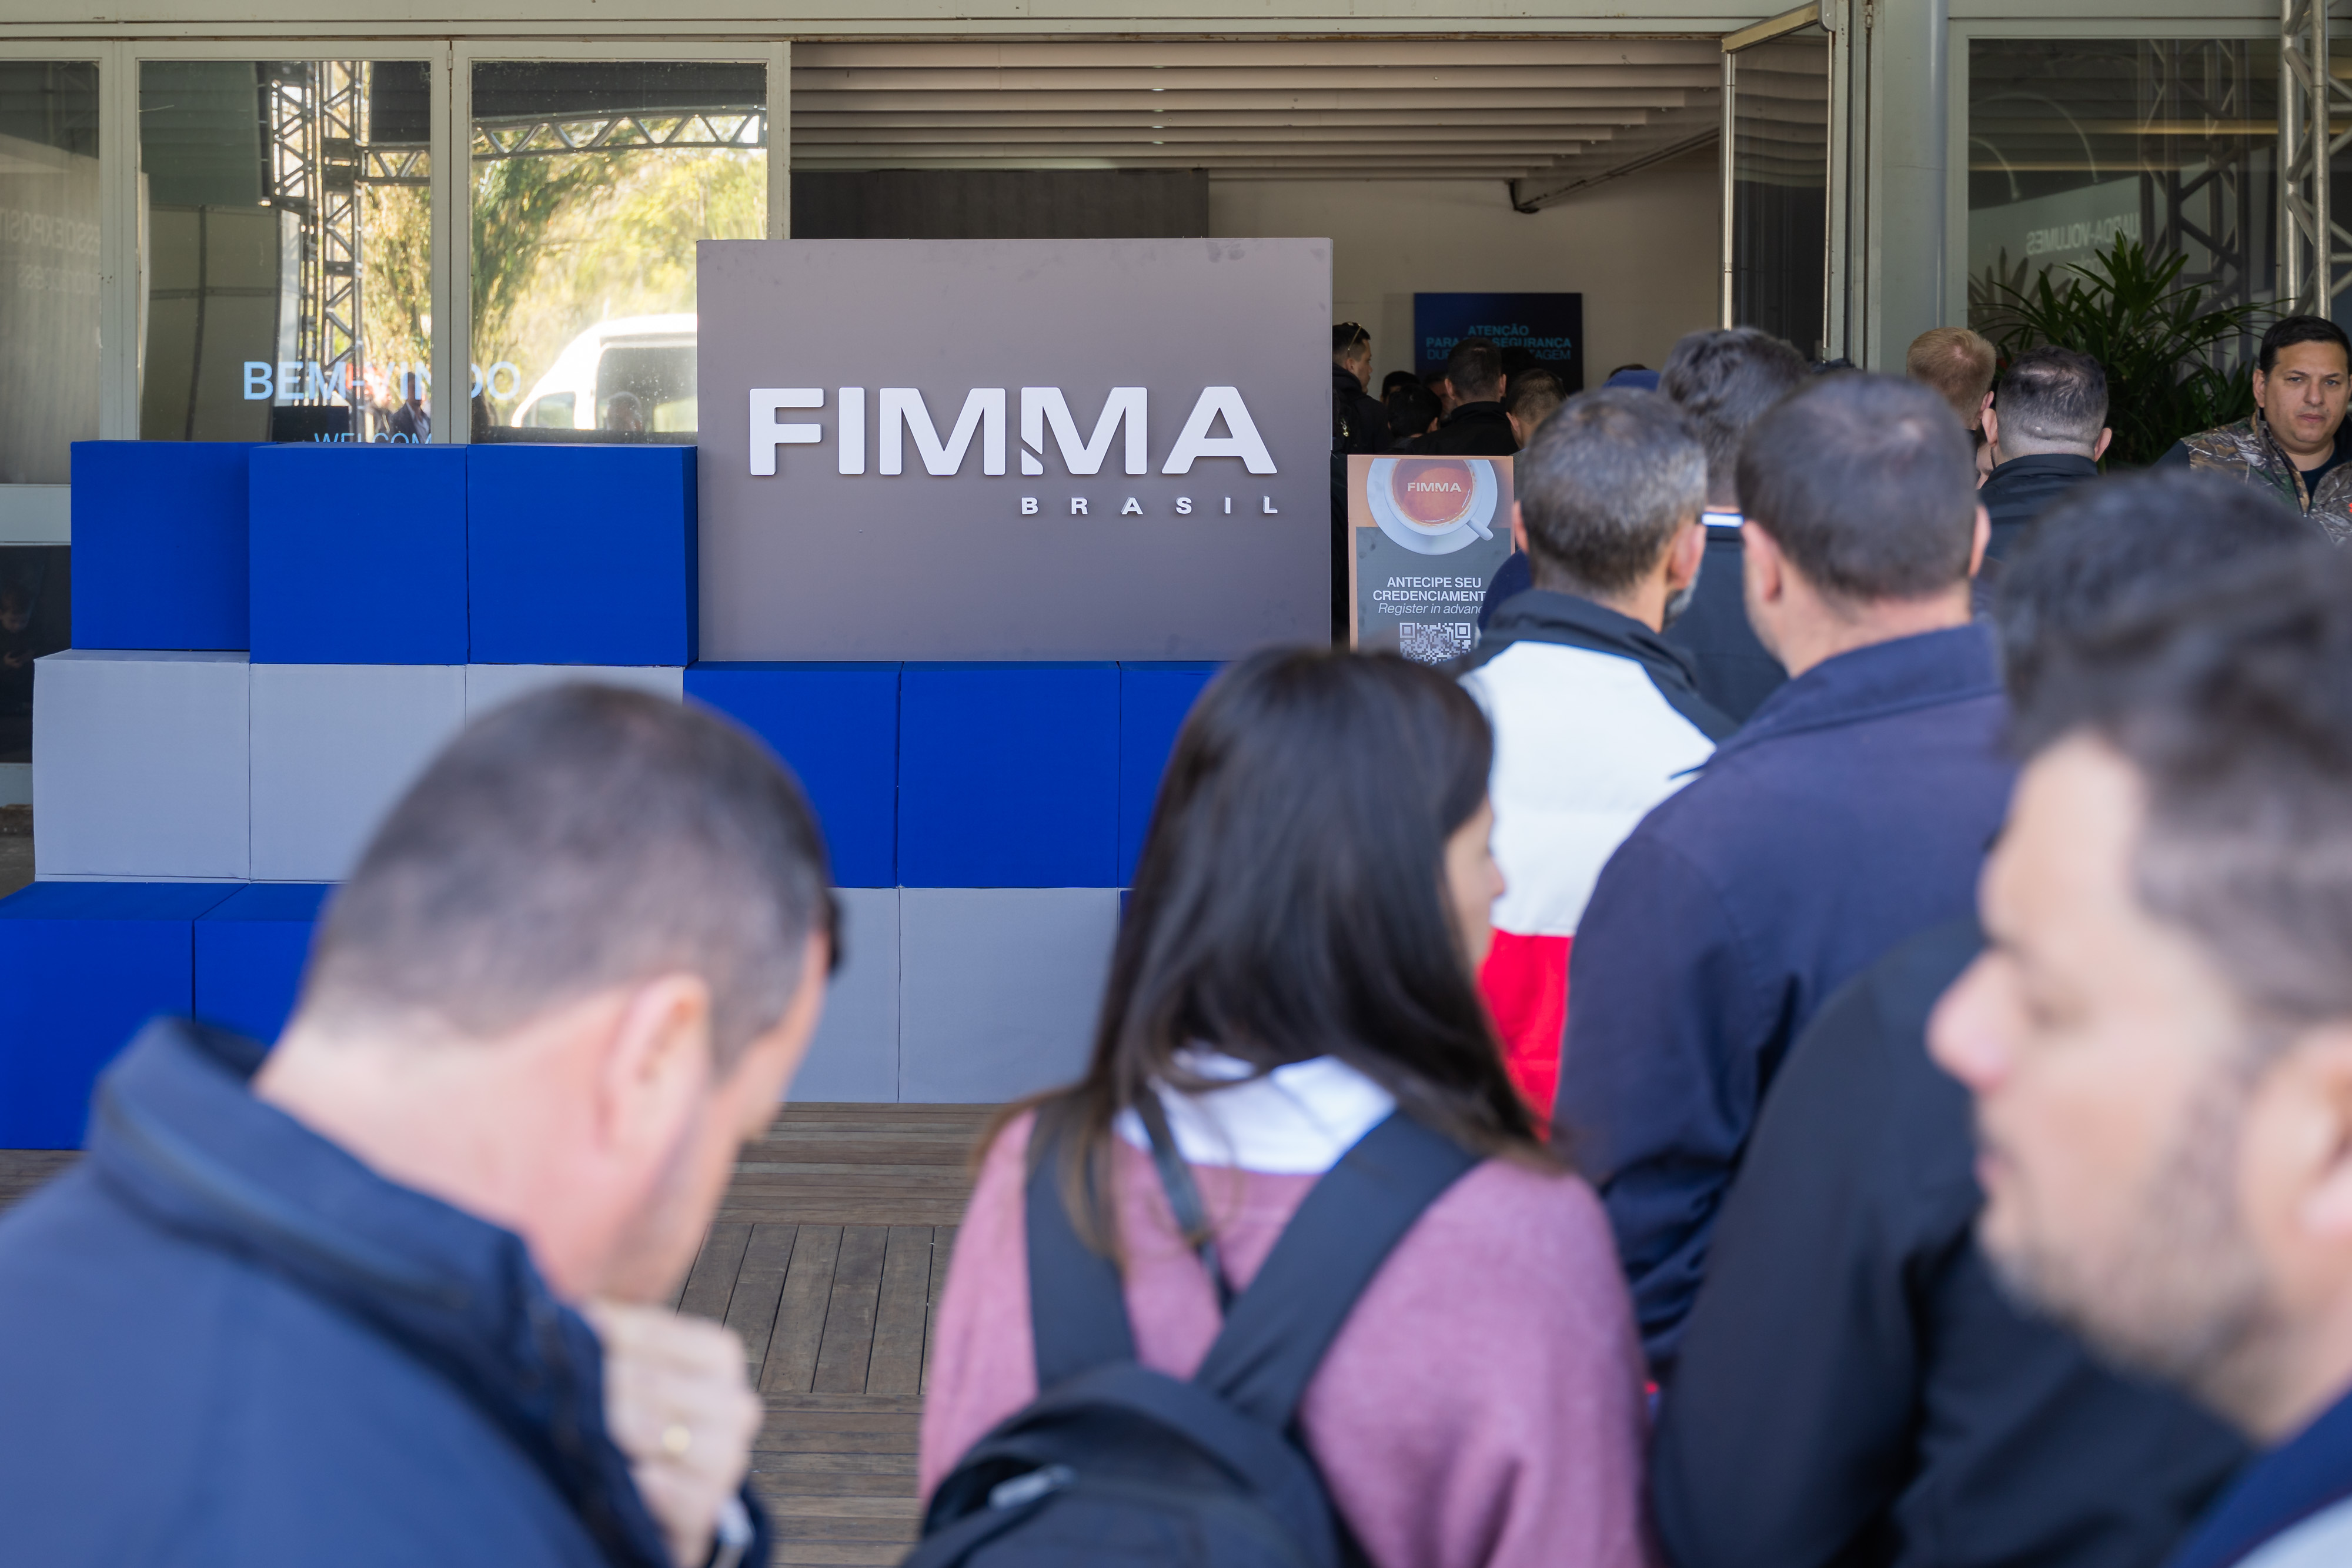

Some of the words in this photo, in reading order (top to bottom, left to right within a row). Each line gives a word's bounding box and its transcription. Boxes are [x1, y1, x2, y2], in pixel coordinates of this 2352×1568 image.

[1468, 323, 1529, 336] ATENÇÃO
[1491, 337, 1572, 349] SEGURANÇA
[749, 386, 1278, 476] FIMMA
[1407, 482, 1462, 492] FIMMA
[1021, 496, 1278, 515] BRASIL
[1387, 577, 1452, 588] ANTECIPE
[1455, 577, 1482, 589] SEU
[1372, 590, 1486, 601] CREDENCIAMENT
[1378, 603, 1429, 616] Register
[1431, 603, 1441, 614] in
[1443, 603, 1482, 614] advan
